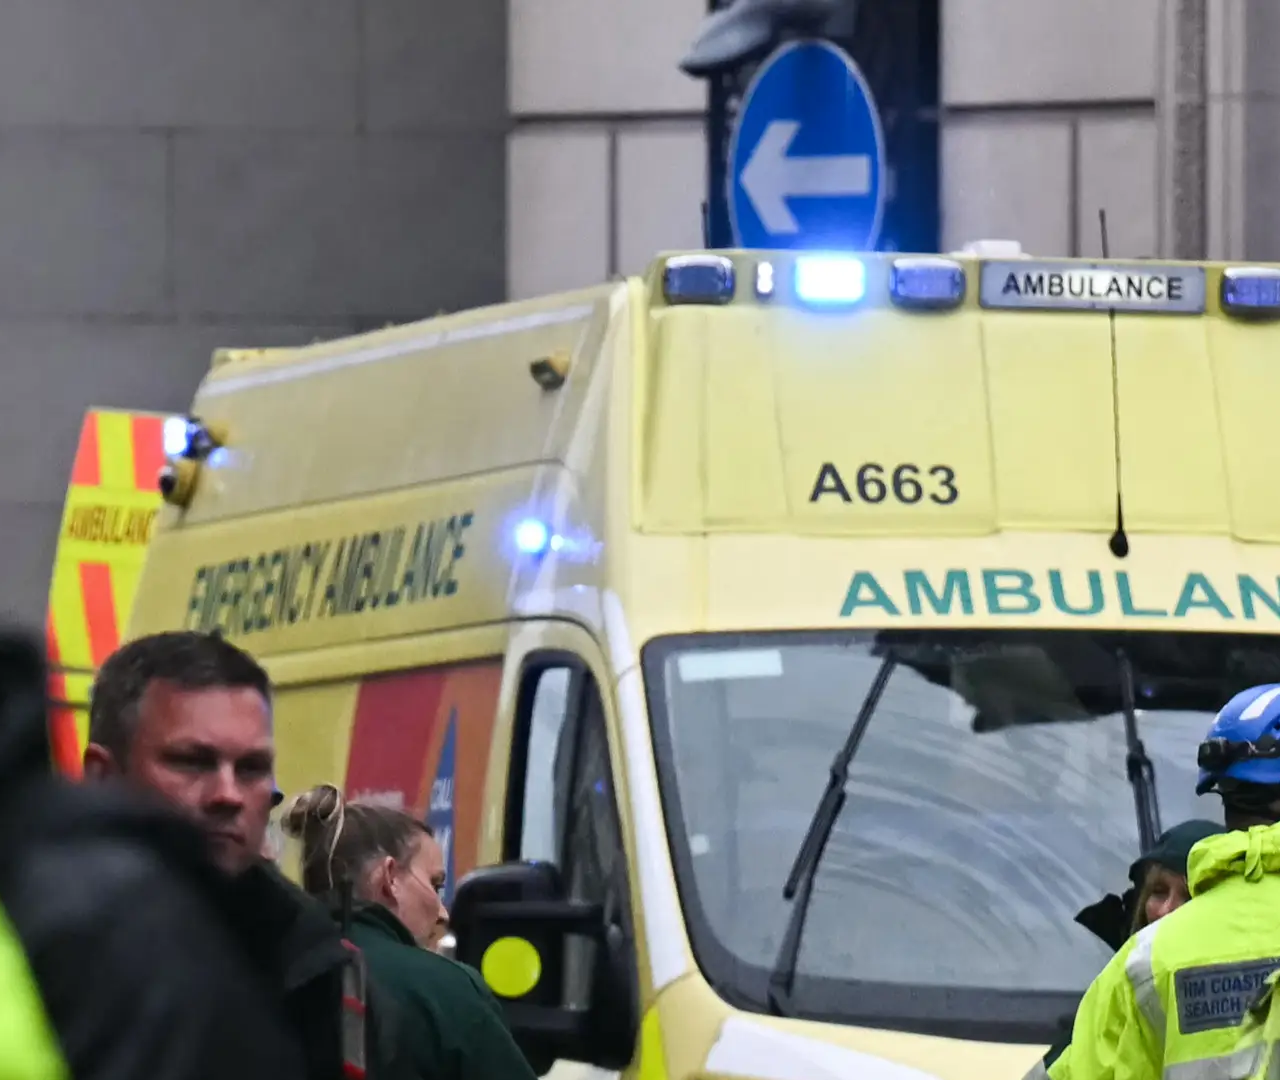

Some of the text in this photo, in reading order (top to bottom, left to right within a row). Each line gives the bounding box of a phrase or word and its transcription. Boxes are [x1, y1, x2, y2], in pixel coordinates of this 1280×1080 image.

[1002, 271, 1184, 300] AMBULANCE
[808, 461, 959, 504] A663
[318, 511, 475, 619] AMBULANCE
[1184, 997, 1241, 1019] SEARCH
